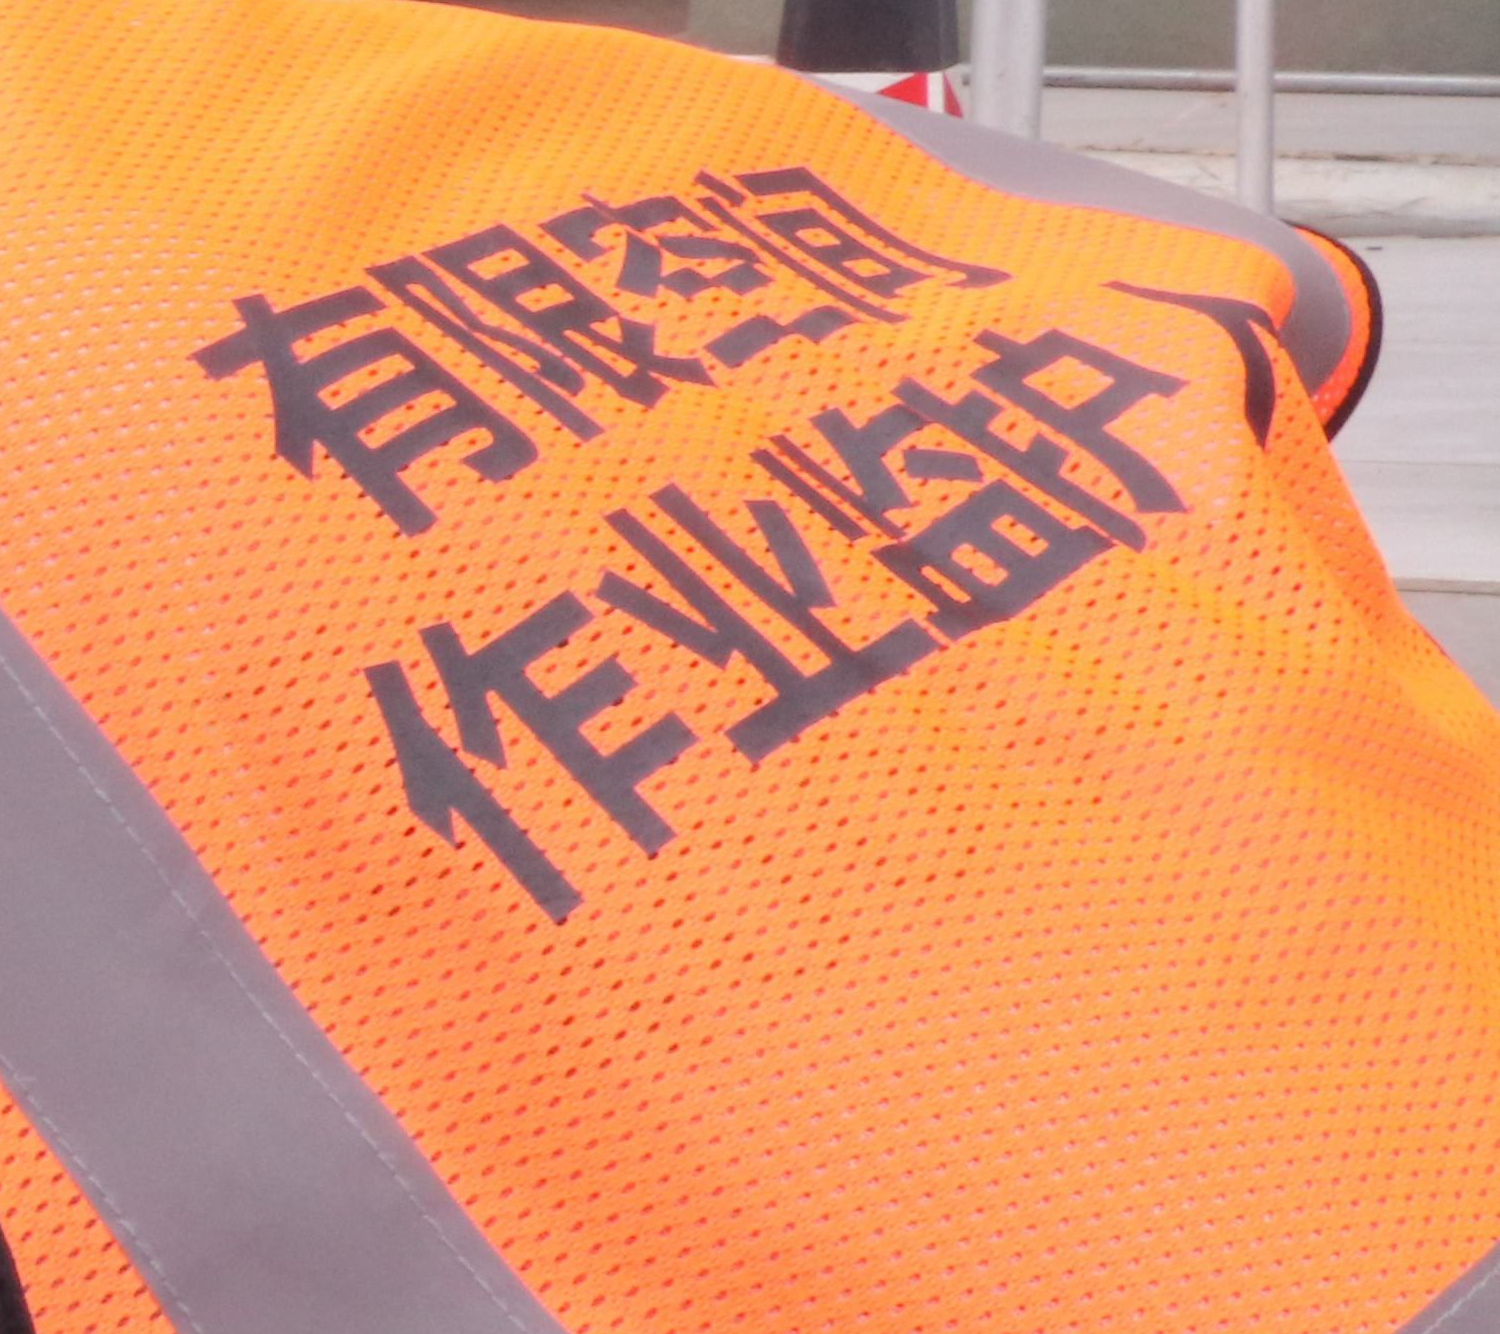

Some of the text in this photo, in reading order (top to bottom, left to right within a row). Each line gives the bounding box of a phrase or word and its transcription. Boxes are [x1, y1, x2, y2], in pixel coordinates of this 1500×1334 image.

[191, 166, 1013, 536] 有限空间
[364, 278, 1278, 925] 作业监护人
